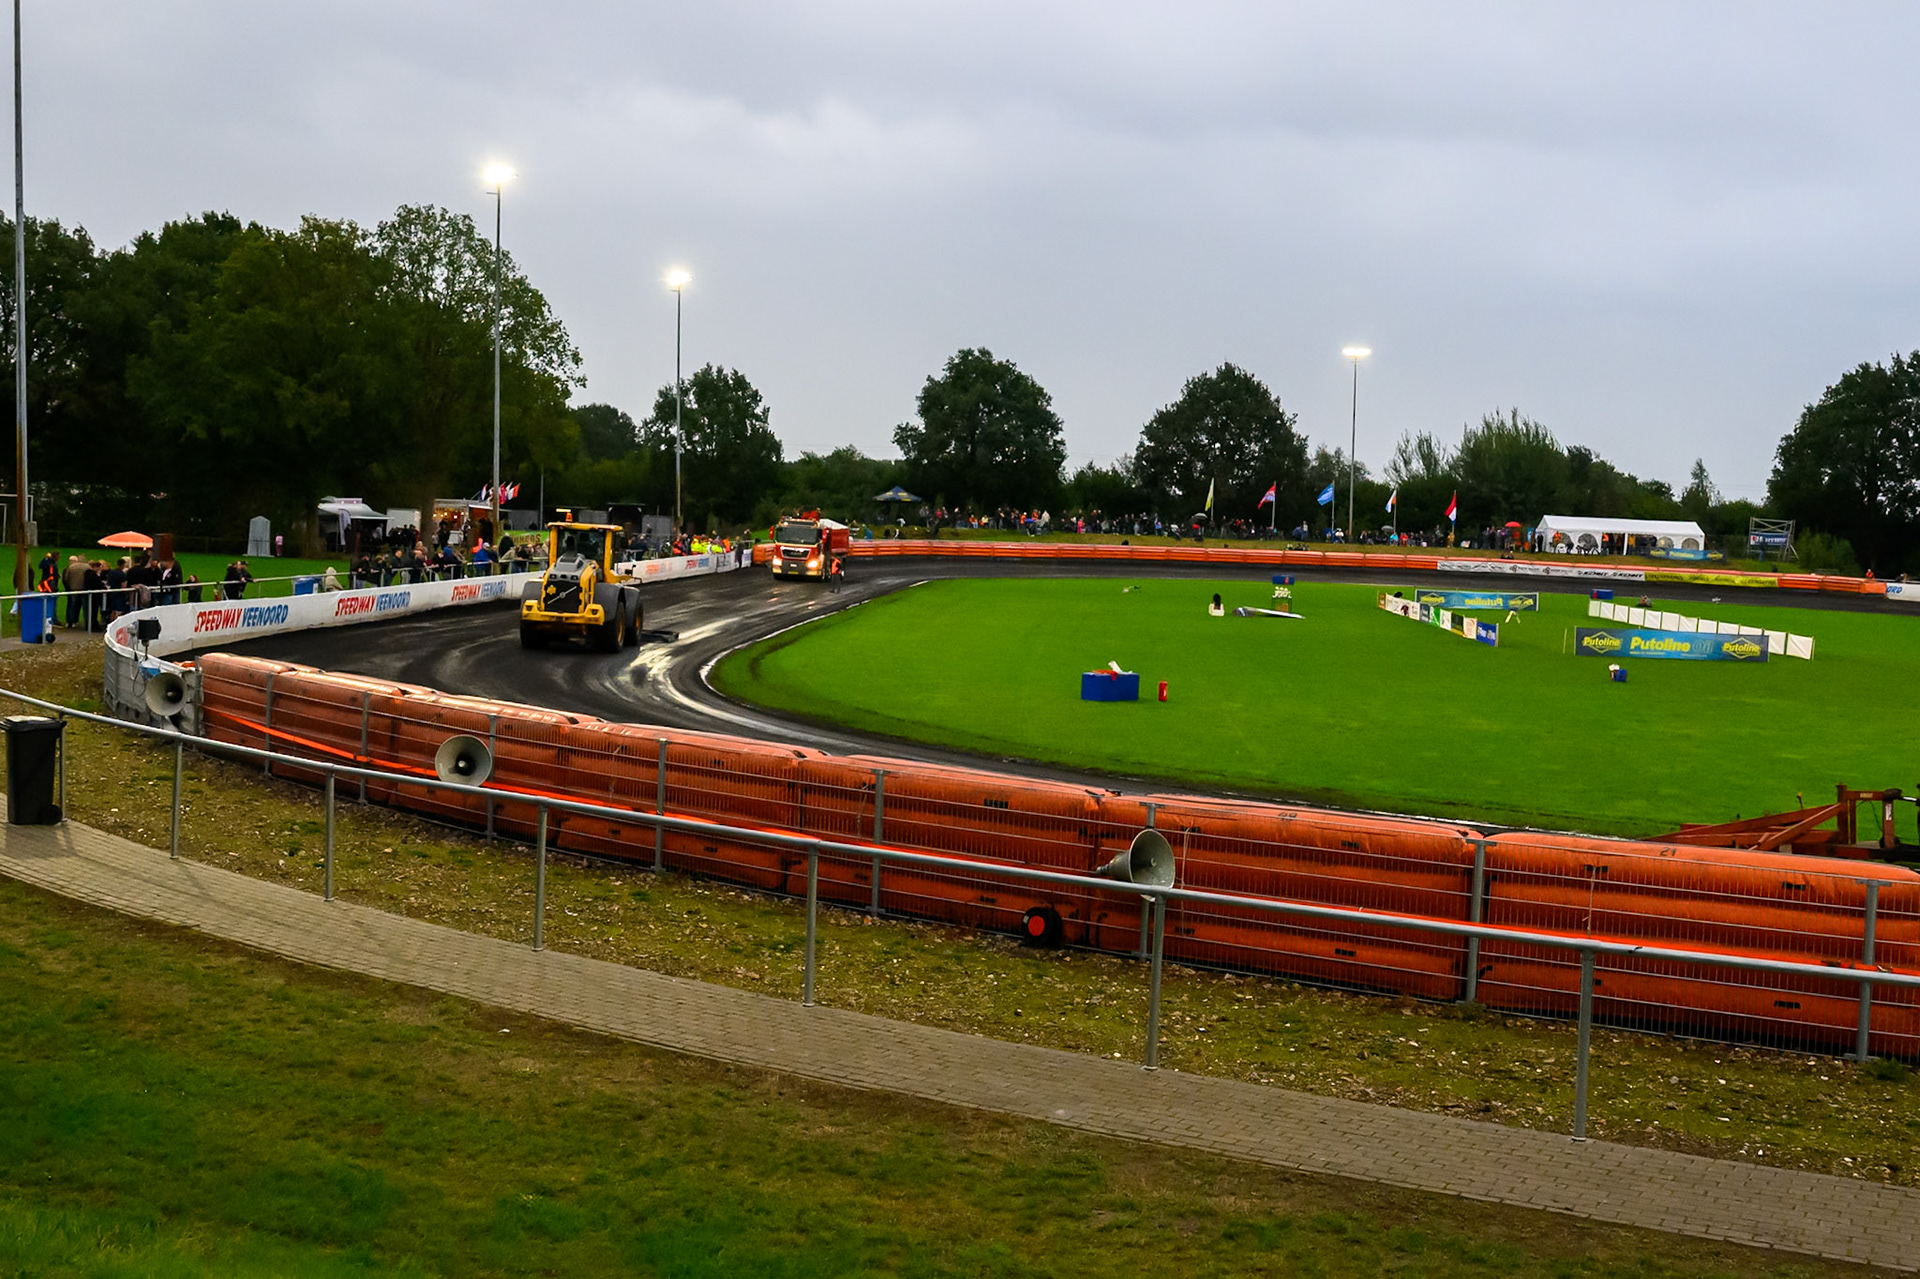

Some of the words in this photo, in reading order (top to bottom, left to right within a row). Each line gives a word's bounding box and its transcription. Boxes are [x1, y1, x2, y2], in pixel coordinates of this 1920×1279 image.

[451, 584, 482, 602] SPEEDWAY
[335, 593, 377, 617] SPEEDWAY
[375, 591, 411, 612] VEENOORD
[194, 608, 243, 633] SPEEDWAY
[241, 604, 290, 628] VEENOORD
[1582, 636, 1621, 648] Putoline
[1630, 637, 1691, 652] Putoline
[1722, 641, 1761, 653] Putoline
